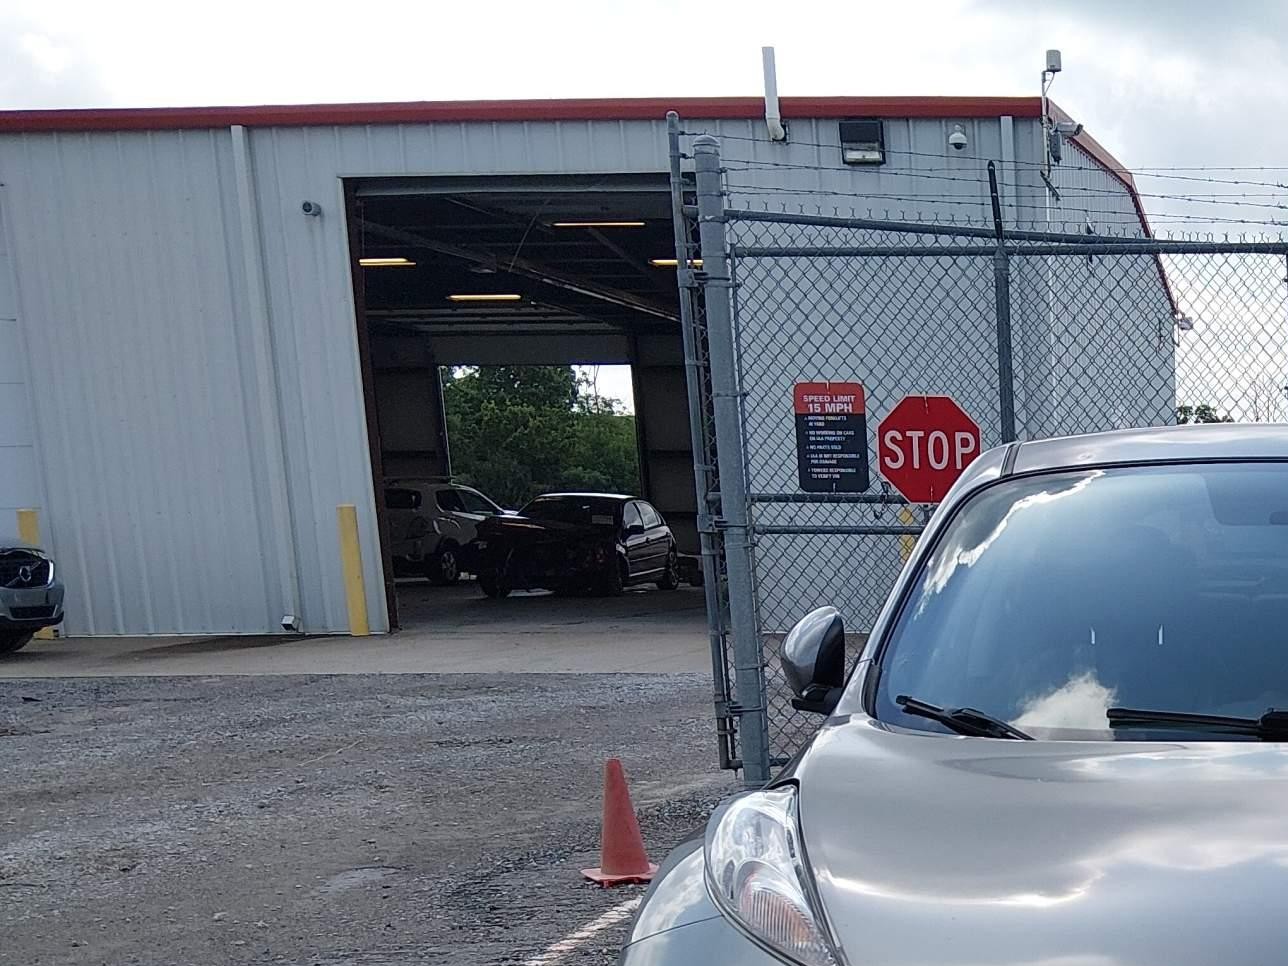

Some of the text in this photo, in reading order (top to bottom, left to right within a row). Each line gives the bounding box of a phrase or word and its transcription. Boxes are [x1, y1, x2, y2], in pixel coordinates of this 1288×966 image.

[802, 395, 856, 403] SPEED LIMIT
[807, 403, 853, 413] 15 MPH
[884, 430, 976, 470] STOP
